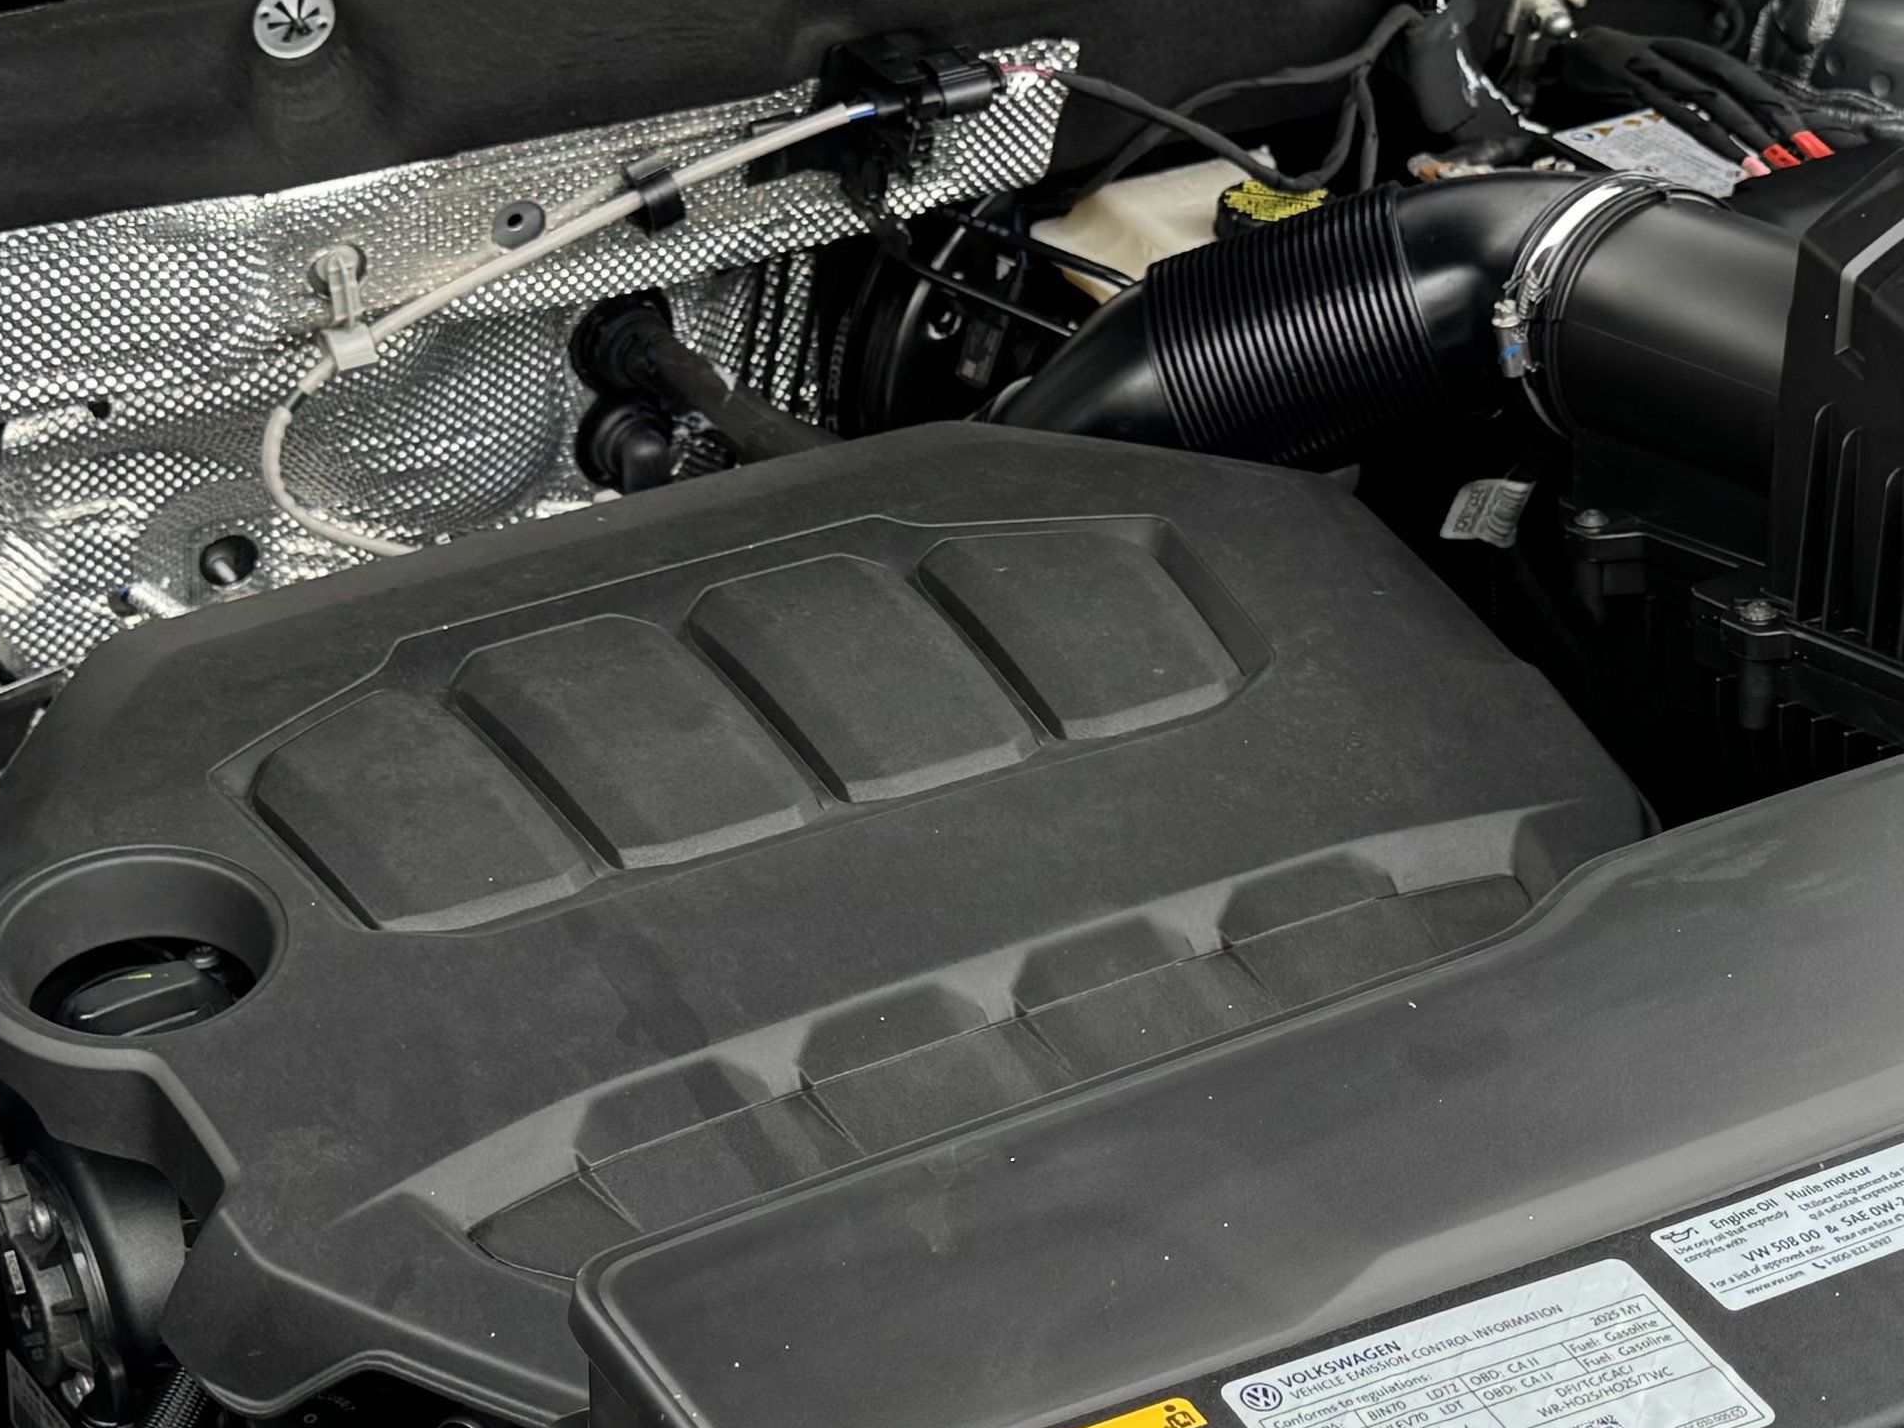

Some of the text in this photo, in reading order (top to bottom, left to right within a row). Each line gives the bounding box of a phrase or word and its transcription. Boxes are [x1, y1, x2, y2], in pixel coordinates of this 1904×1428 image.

[1785, 1166, 1871, 1201] Huile moteur
[1709, 1198, 1779, 1230] Engine Oil
[1741, 1245, 1771, 1262] VW
[1769, 1236, 1800, 1252] 508
[1798, 1229, 1821, 1242] 00
[1824, 1225, 1839, 1233] &
[1840, 1210, 1871, 1227] SAE
[1589, 1302, 1642, 1326] 2025 MY
[1278, 1340, 1402, 1388] VOLKSWAGEN
[1289, 1304, 1564, 1400] VEHICLE EMISSION CONTROL INFORMATION
[1366, 1400, 1407, 1420] BIN70
[1425, 1382, 1460, 1401] LDT2
[1469, 1369, 1505, 1386] OBD:
[1506, 1360, 1529, 1374] CA
[1568, 1337, 1602, 1354] Fuel:
[1603, 1320, 1659, 1342] Gasoline
[1438, 1399, 1464, 1415] LDT
[1520, 1375, 1542, 1388] CA
[1582, 1351, 1613, 1368] Fuel:
[1617, 1334, 1673, 1357] Gasoline
[1337, 1398, 1354, 1409] to
[1355, 1374, 1433, 1404] regulations:
